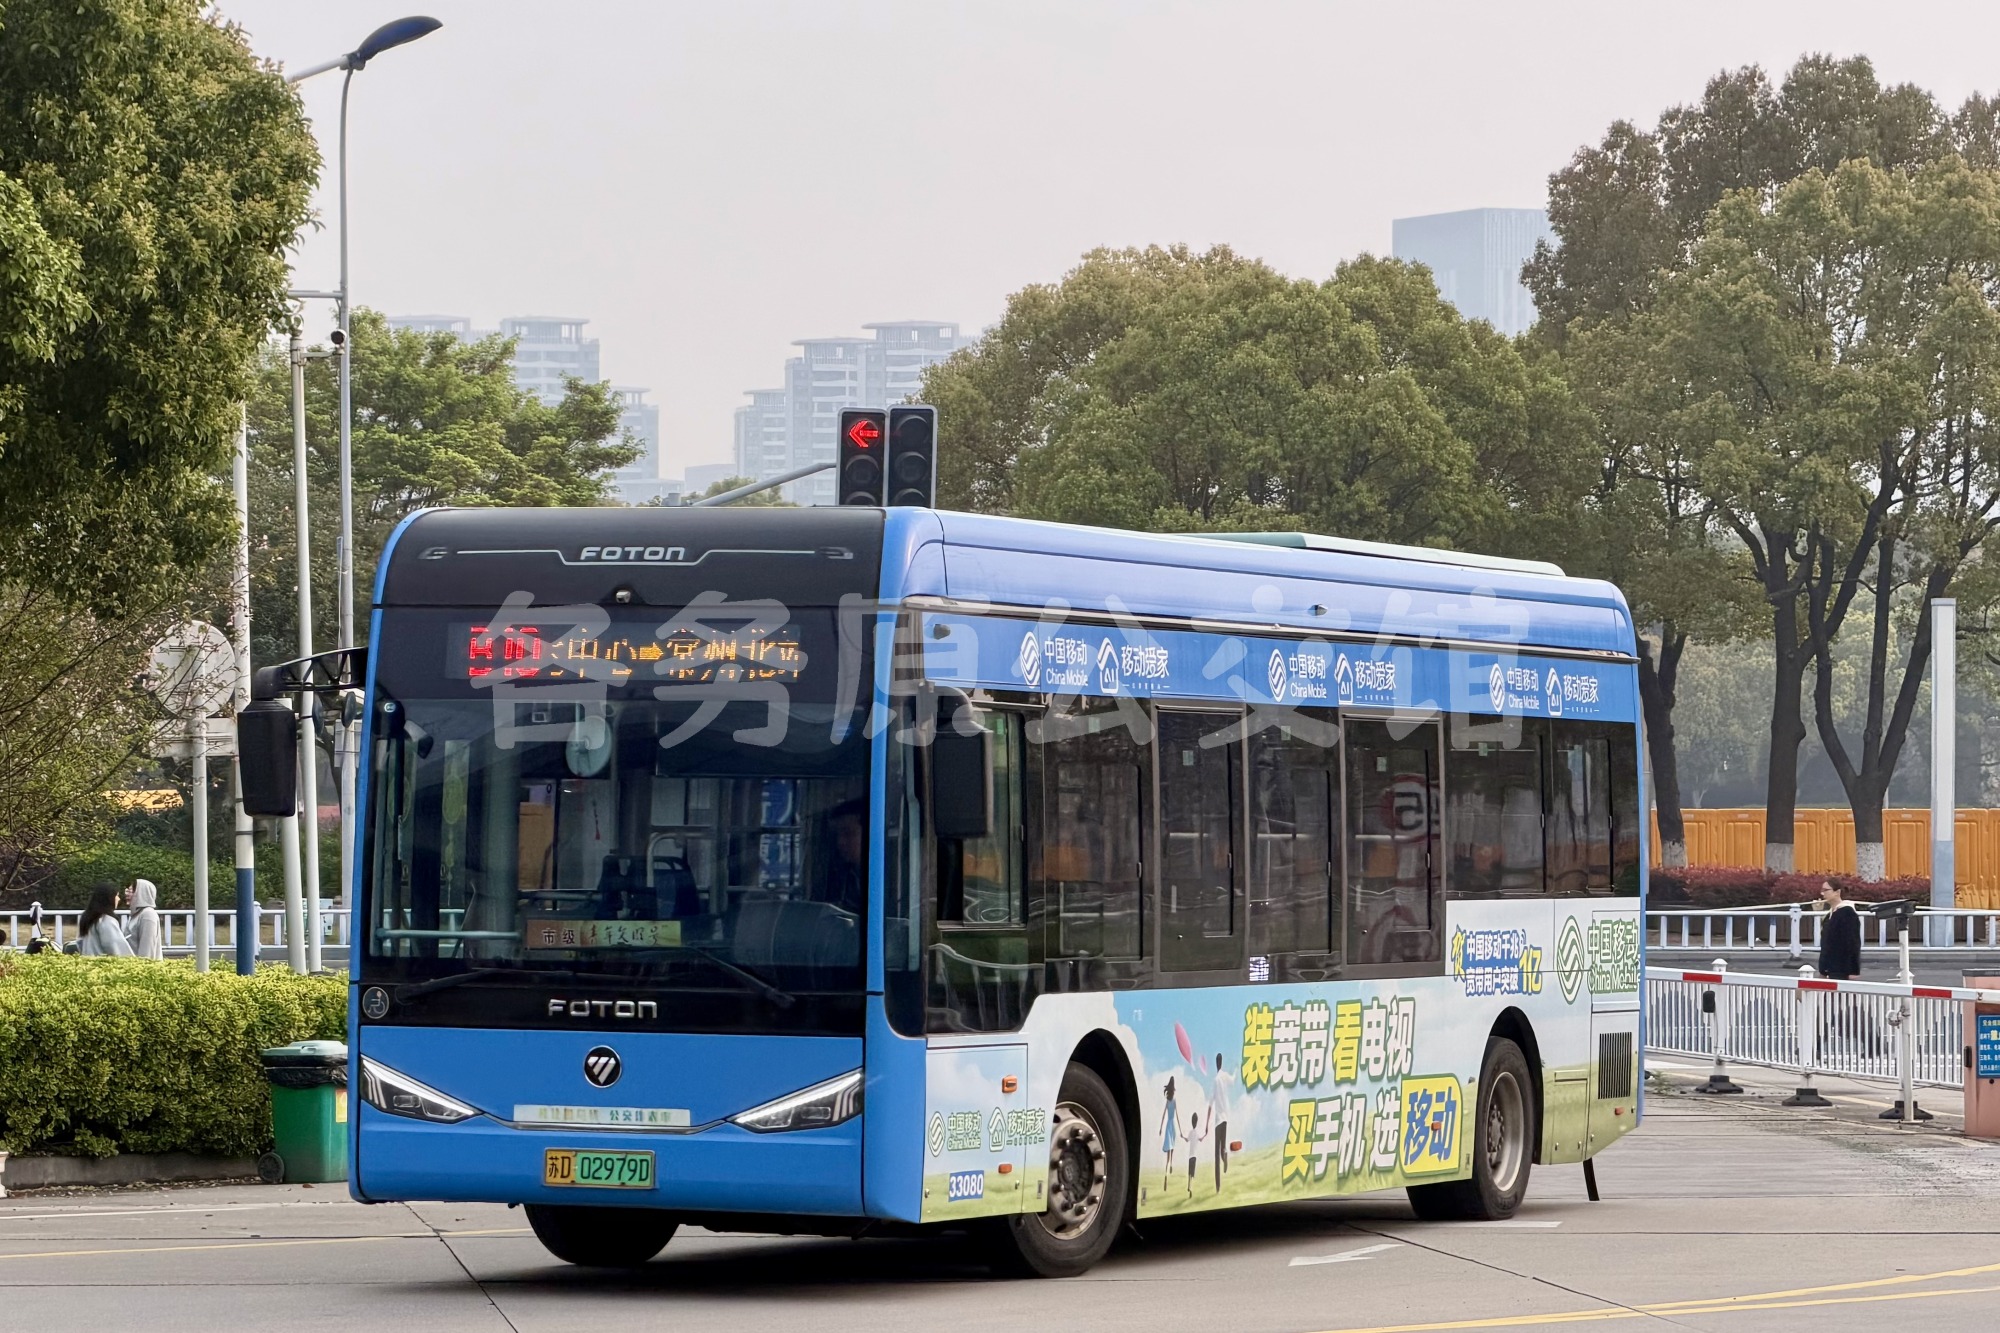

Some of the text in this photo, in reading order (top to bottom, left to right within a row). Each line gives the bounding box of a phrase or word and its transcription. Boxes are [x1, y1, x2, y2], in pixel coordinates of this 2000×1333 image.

[580, 546, 685, 560] FOTON
[1044, 636, 1088, 666] 中国移动
[1121, 645, 1170, 679] 移动爱家
[1045, 668, 1089, 687] China Mobile
[1288, 653, 1326, 680] 中国移动
[1355, 660, 1396, 690] 移动爱家
[1506, 666, 1539, 692] 中国移动
[1290, 682, 1327, 699] China Mobile
[1563, 674, 1599, 703] 移动爱家
[1508, 694, 1540, 710] China Mobile
[1588, 918, 1640, 964] 中国移动
[1588, 964, 1611, 993] China
[548, 998, 657, 1019] FOTON
[1241, 995, 1416, 1091] 装宽带看电视
[947, 1110, 982, 1135] 中国移动
[1007, 1107, 1046, 1137] 移动爱家
[947, 1134, 982, 1151] China Mobile
[949, 1173, 984, 1198] 33080
